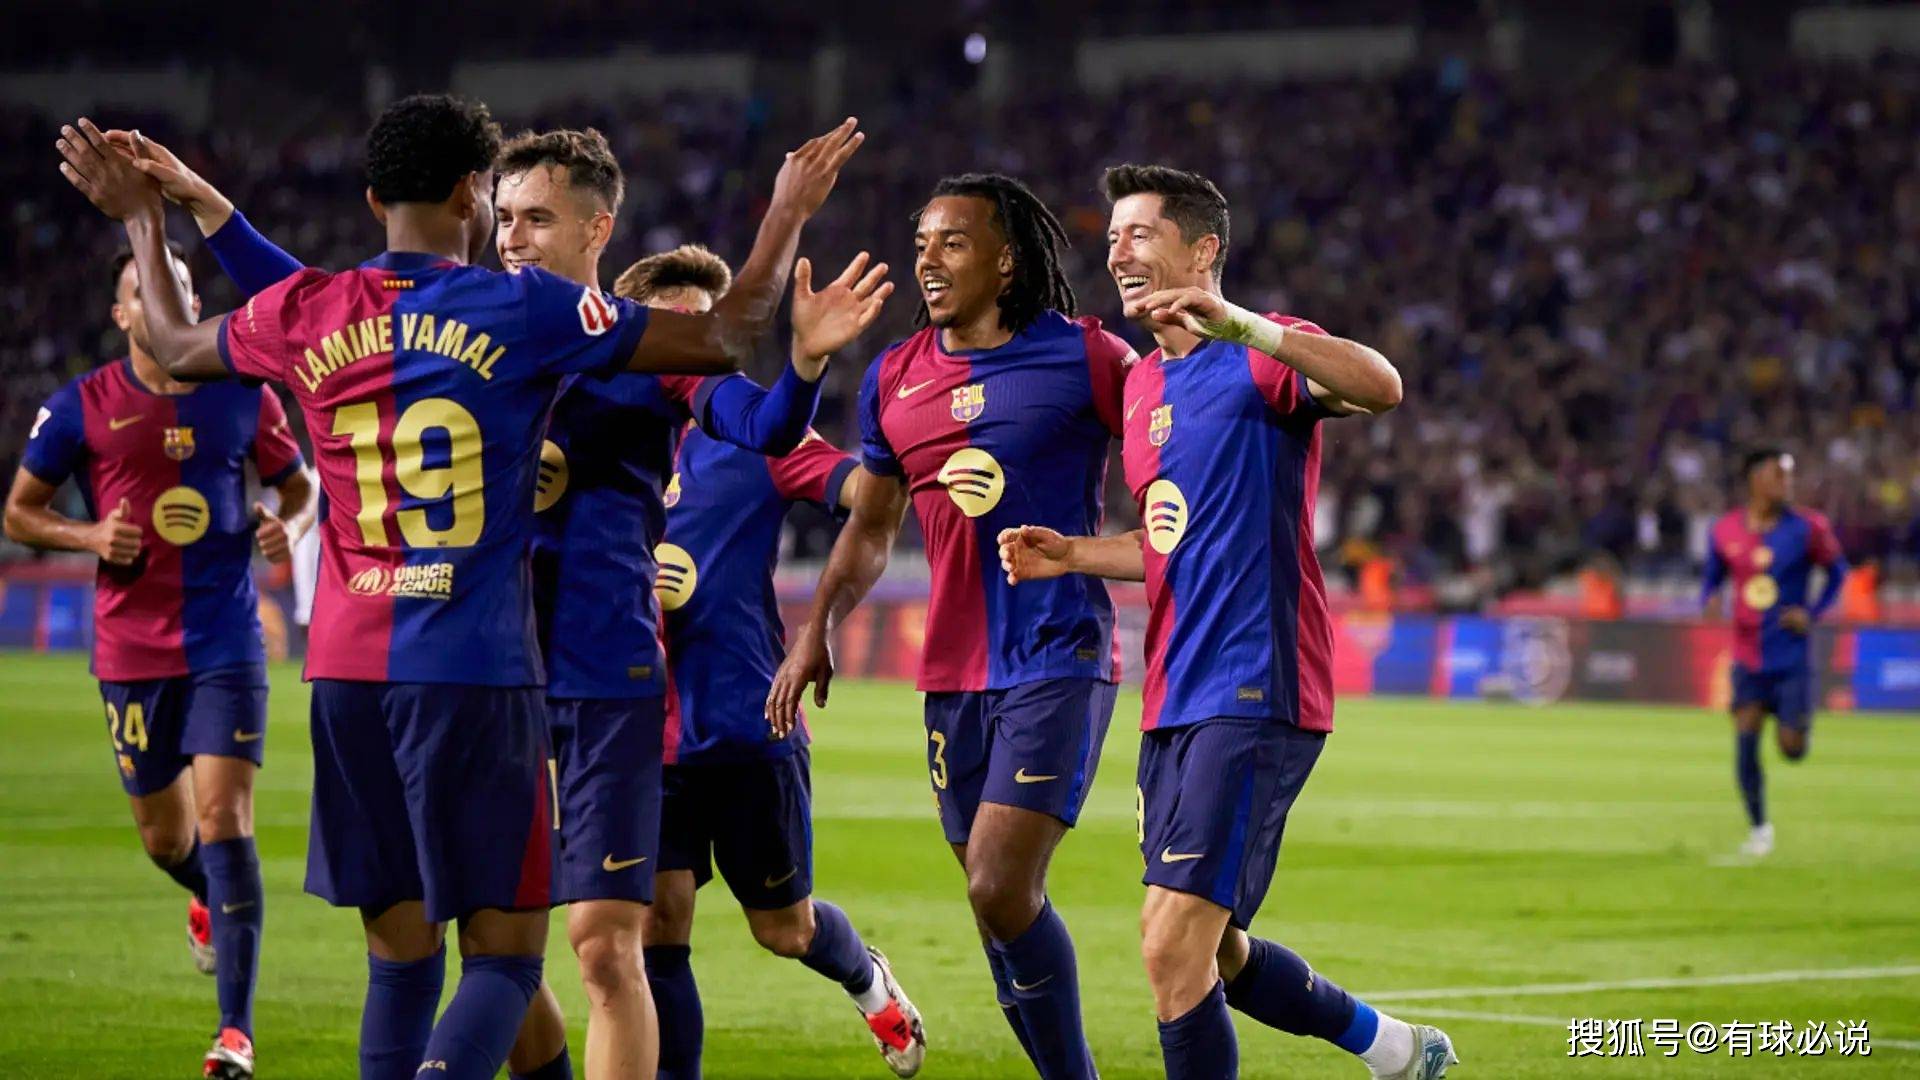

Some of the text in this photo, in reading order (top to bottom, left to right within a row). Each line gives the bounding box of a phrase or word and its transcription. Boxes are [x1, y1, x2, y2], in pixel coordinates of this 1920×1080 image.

[295, 313, 506, 393] LAMINE YAMAL
[332, 398, 484, 548] 19
[386, 578, 451, 595] ACNUR
[394, 563, 453, 581] UNHCR
[930, 730, 948, 790] 3
